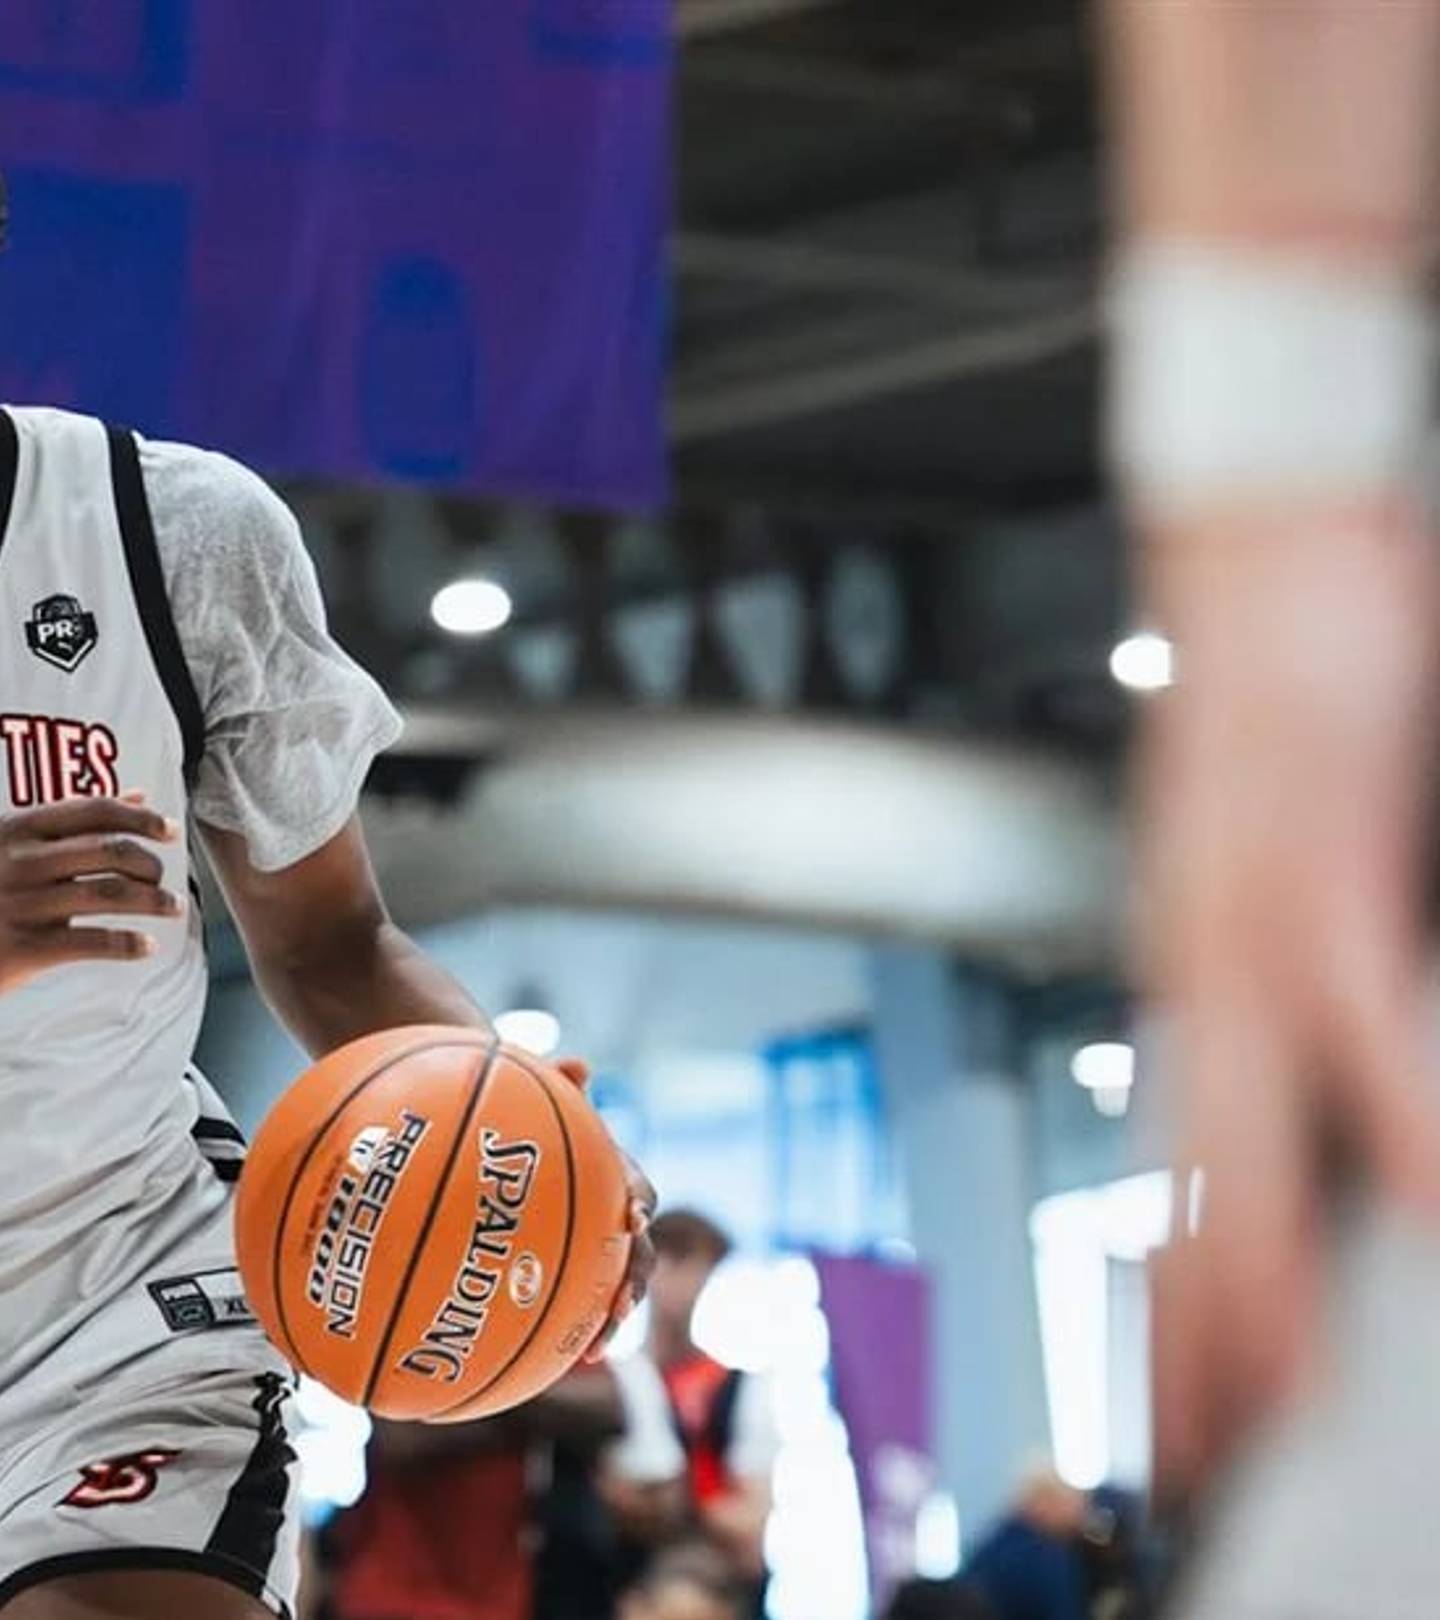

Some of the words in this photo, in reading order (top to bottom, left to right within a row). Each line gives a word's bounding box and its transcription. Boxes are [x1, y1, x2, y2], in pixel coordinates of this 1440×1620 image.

[308, 1173, 357, 1307] 1000
[327, 1108, 432, 1340] PRECISION
[399, 1128, 540, 1382] SPALDING
